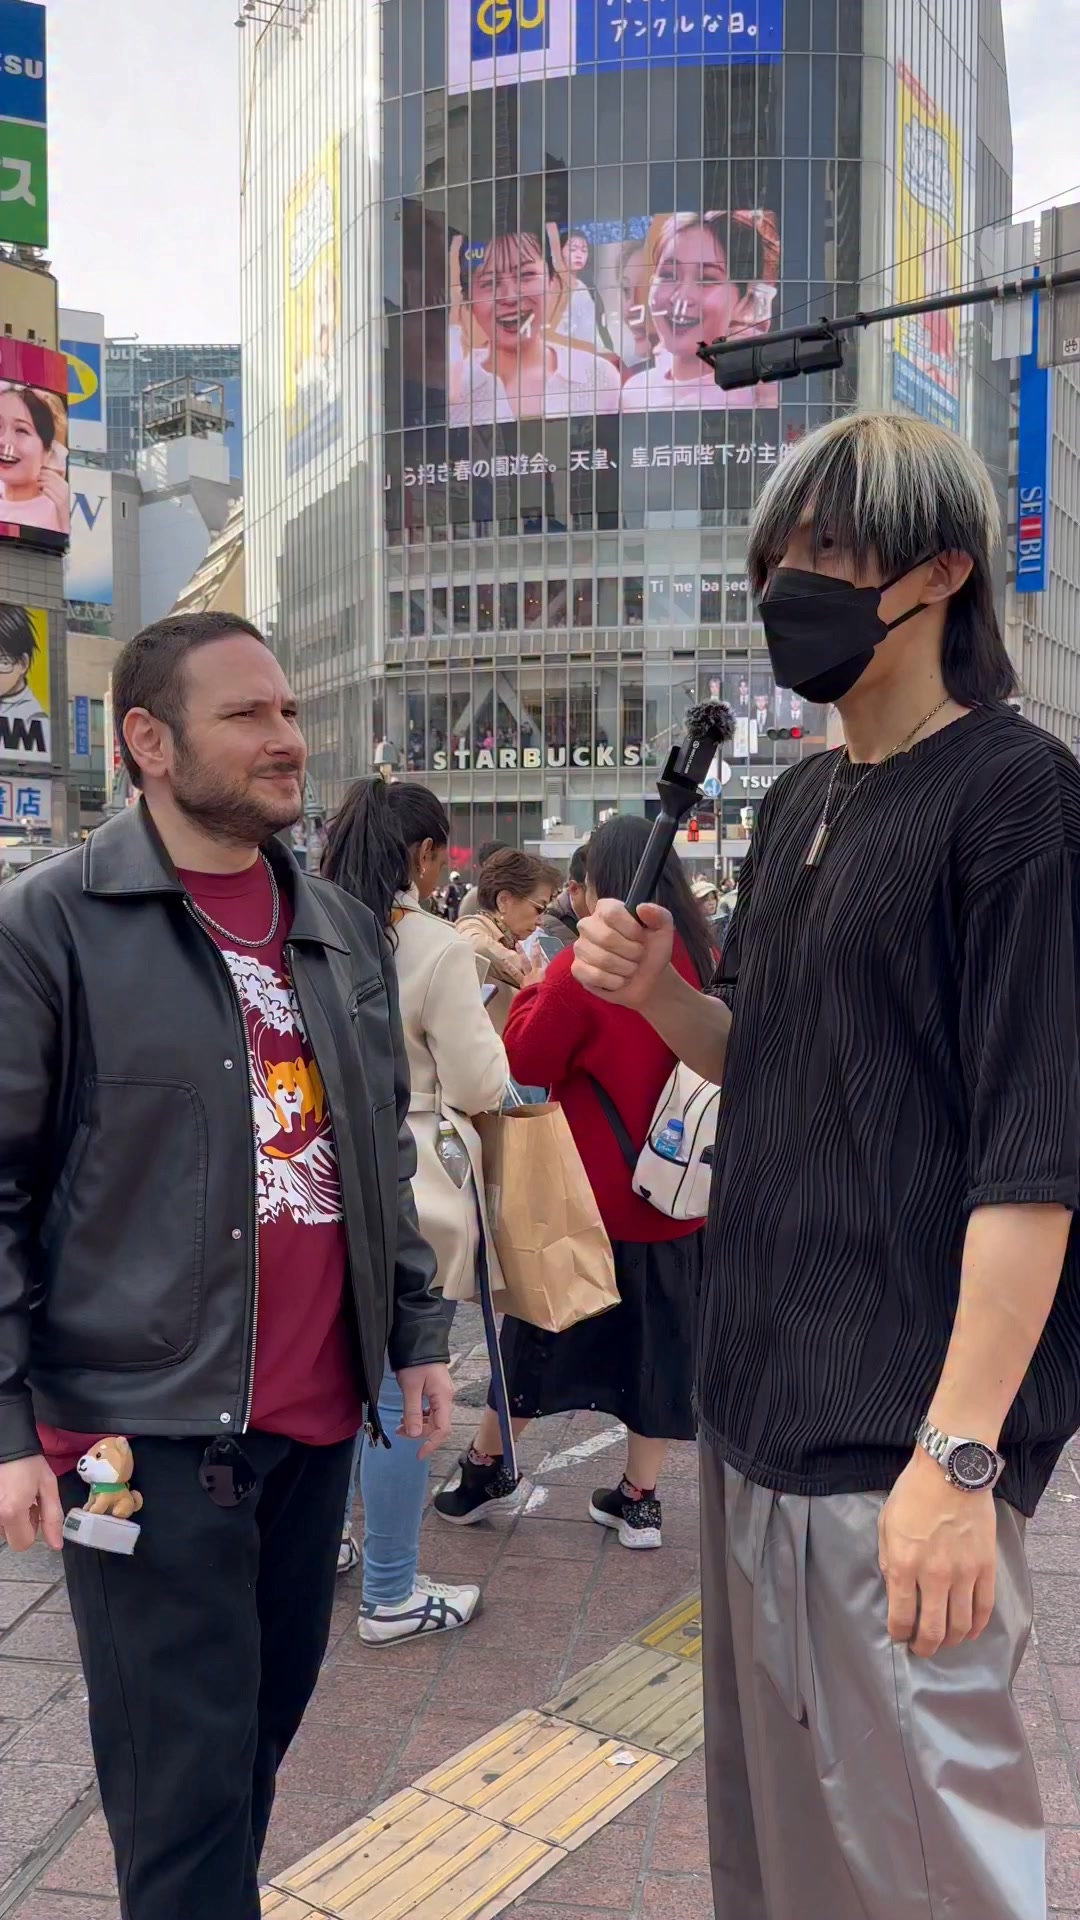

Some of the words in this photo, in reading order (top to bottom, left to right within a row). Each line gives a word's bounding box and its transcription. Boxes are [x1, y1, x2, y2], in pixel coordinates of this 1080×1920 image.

[477, 0, 545, 35] GU
[0, 53, 44, 79] SU
[1019, 486, 1043, 575] SEIBU
[433, 745, 641, 770] STARBUCKS
